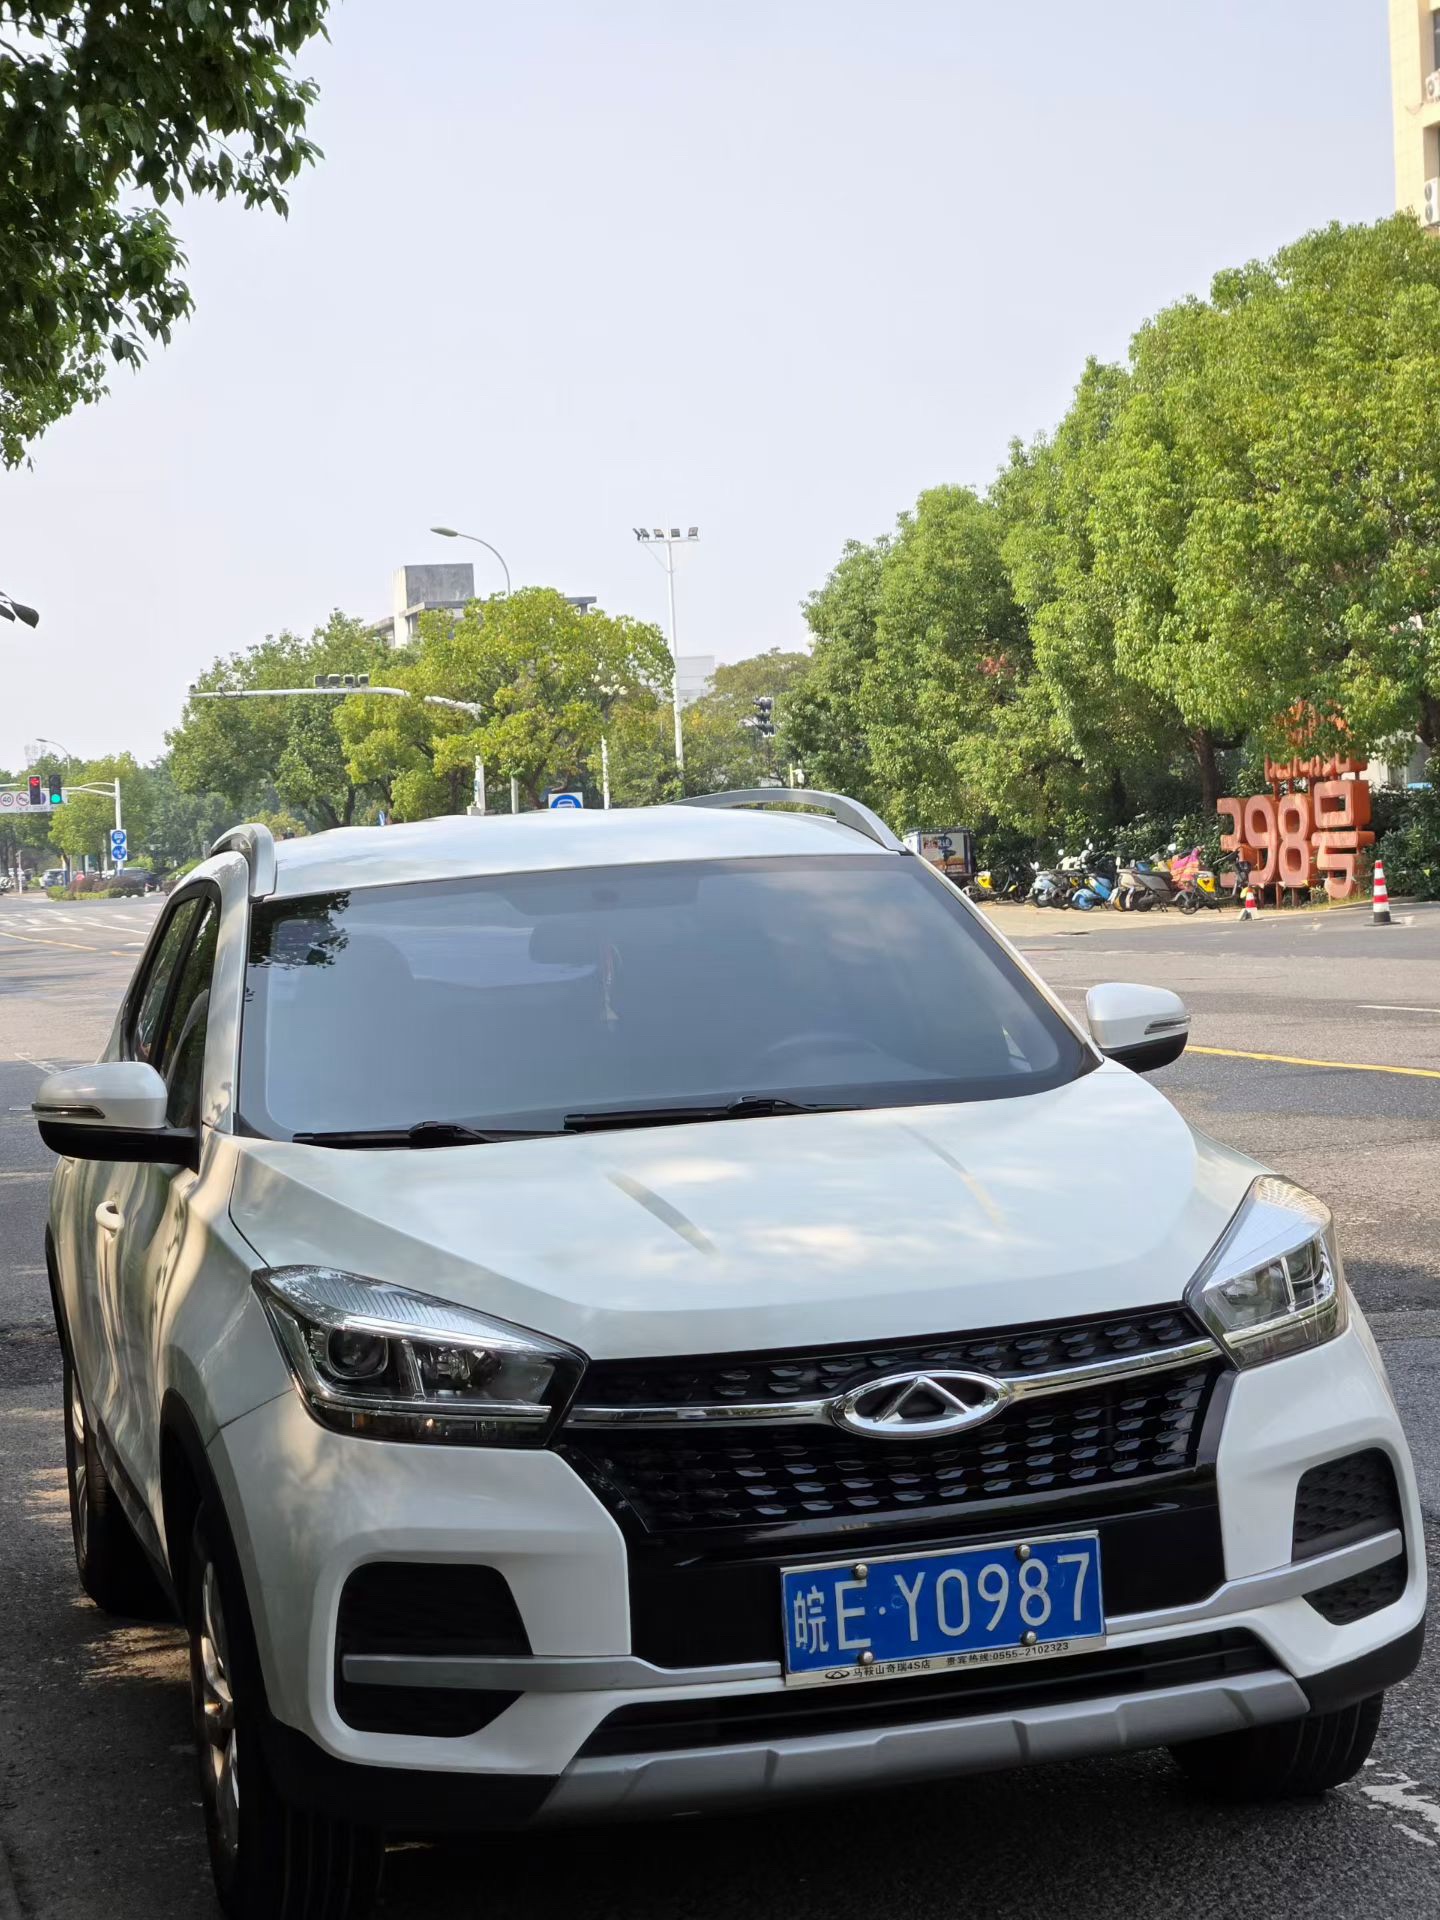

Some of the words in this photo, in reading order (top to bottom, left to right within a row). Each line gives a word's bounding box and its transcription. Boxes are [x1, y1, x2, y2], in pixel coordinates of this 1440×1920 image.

[853, 1659, 931, 1678] 马鞍山奇瑞4S店
